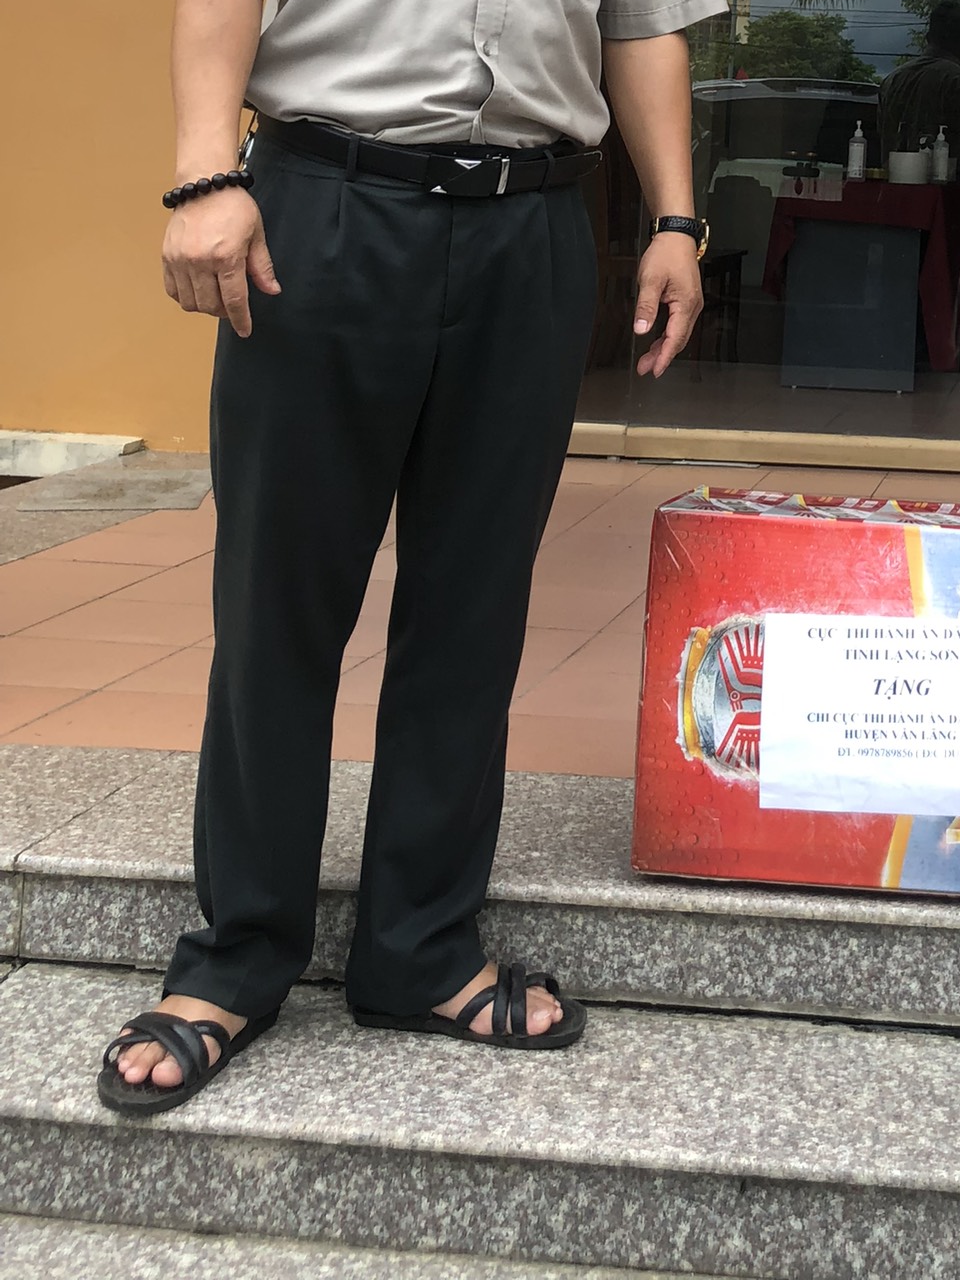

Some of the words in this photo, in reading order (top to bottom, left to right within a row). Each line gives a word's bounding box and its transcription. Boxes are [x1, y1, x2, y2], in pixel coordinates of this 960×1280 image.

[807, 627, 838, 642] CỤC
[844, 628, 869, 639] THI
[874, 625, 915, 639] HÀNH
[884, 649, 926, 664] LẠNG
[873, 675, 932, 701] TẶNG
[807, 711, 829, 723] CHI
[833, 712, 860, 726] CỤC
[863, 713, 884, 724] THI
[887, 711, 924, 724] HÀNH
[844, 729, 889, 742] HUYỆN
[891, 727, 918, 740] VĂN
[857, 747, 914, 759] 0978789856
